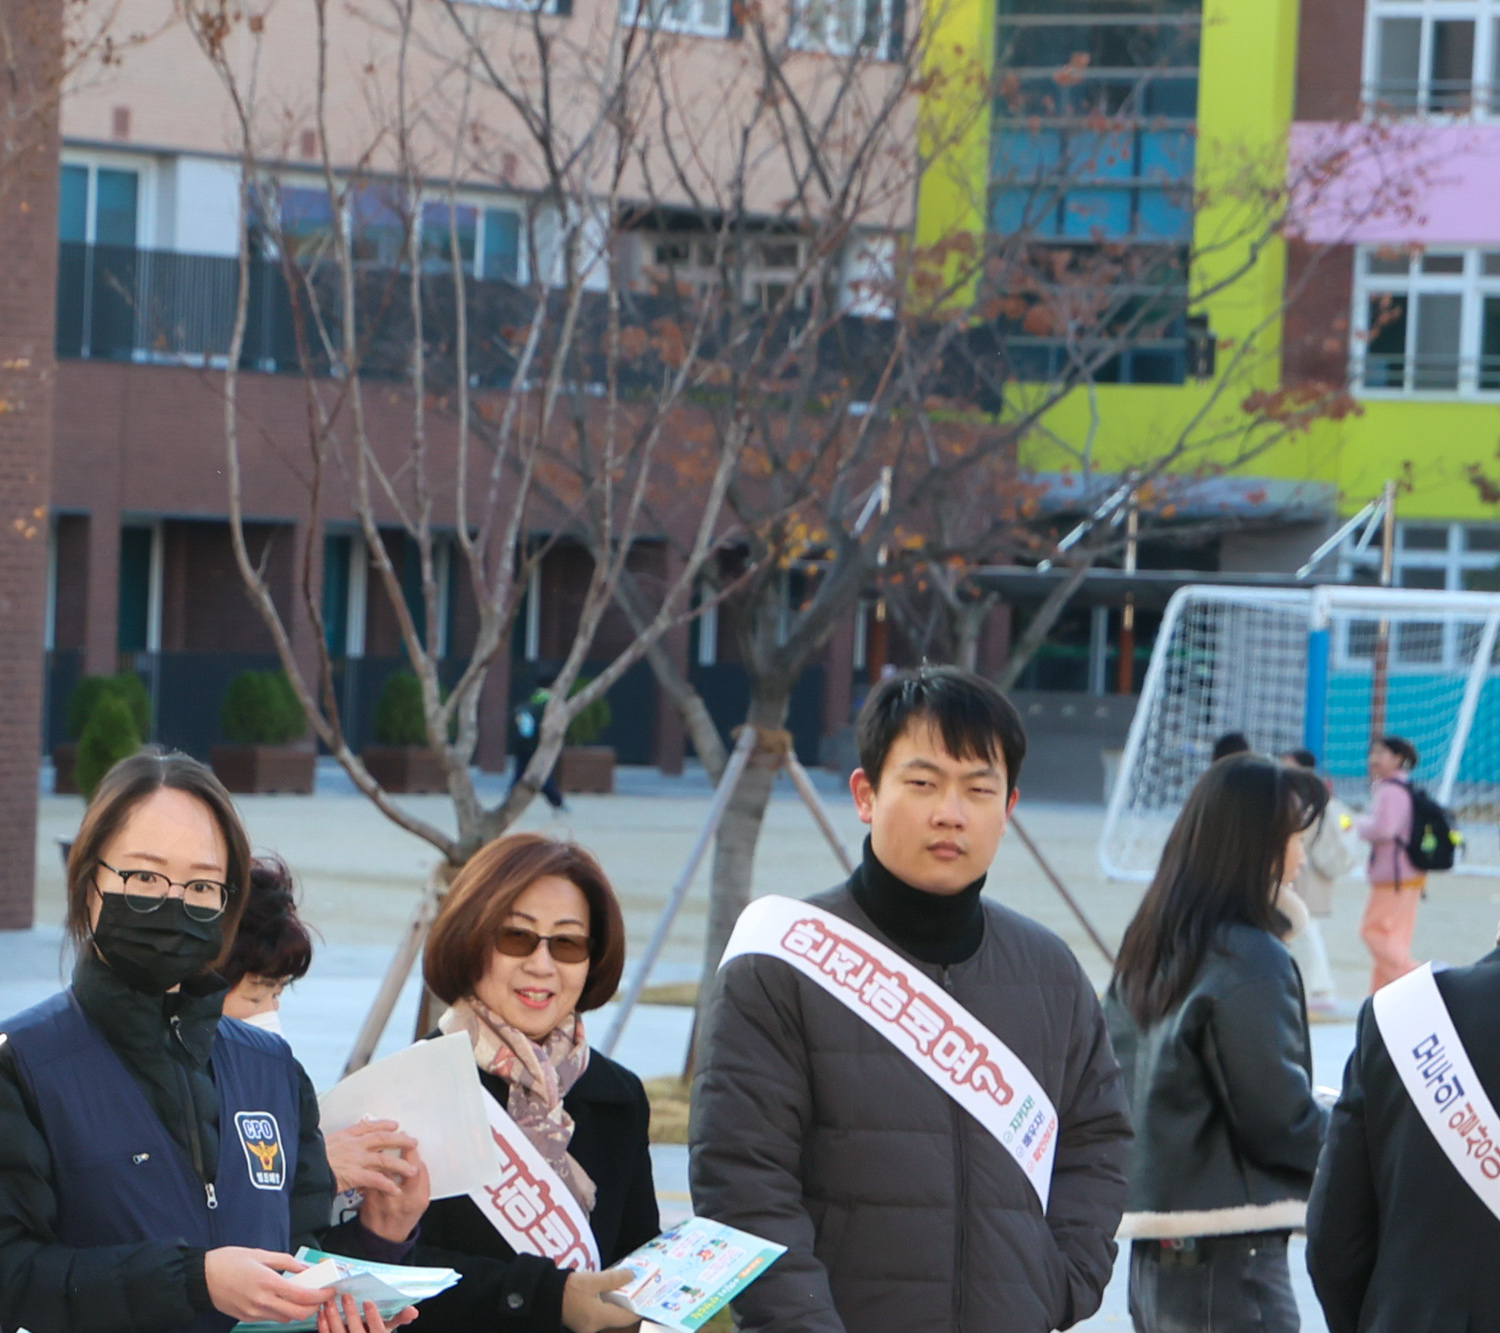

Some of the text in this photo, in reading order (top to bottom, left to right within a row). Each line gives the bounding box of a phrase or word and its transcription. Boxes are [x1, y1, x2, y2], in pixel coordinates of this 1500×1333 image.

[780, 918, 1014, 1106] 안전하세요?
[1412, 1032, 1465, 1113] 모두의
[242, 1119, 273, 1140] CPO
